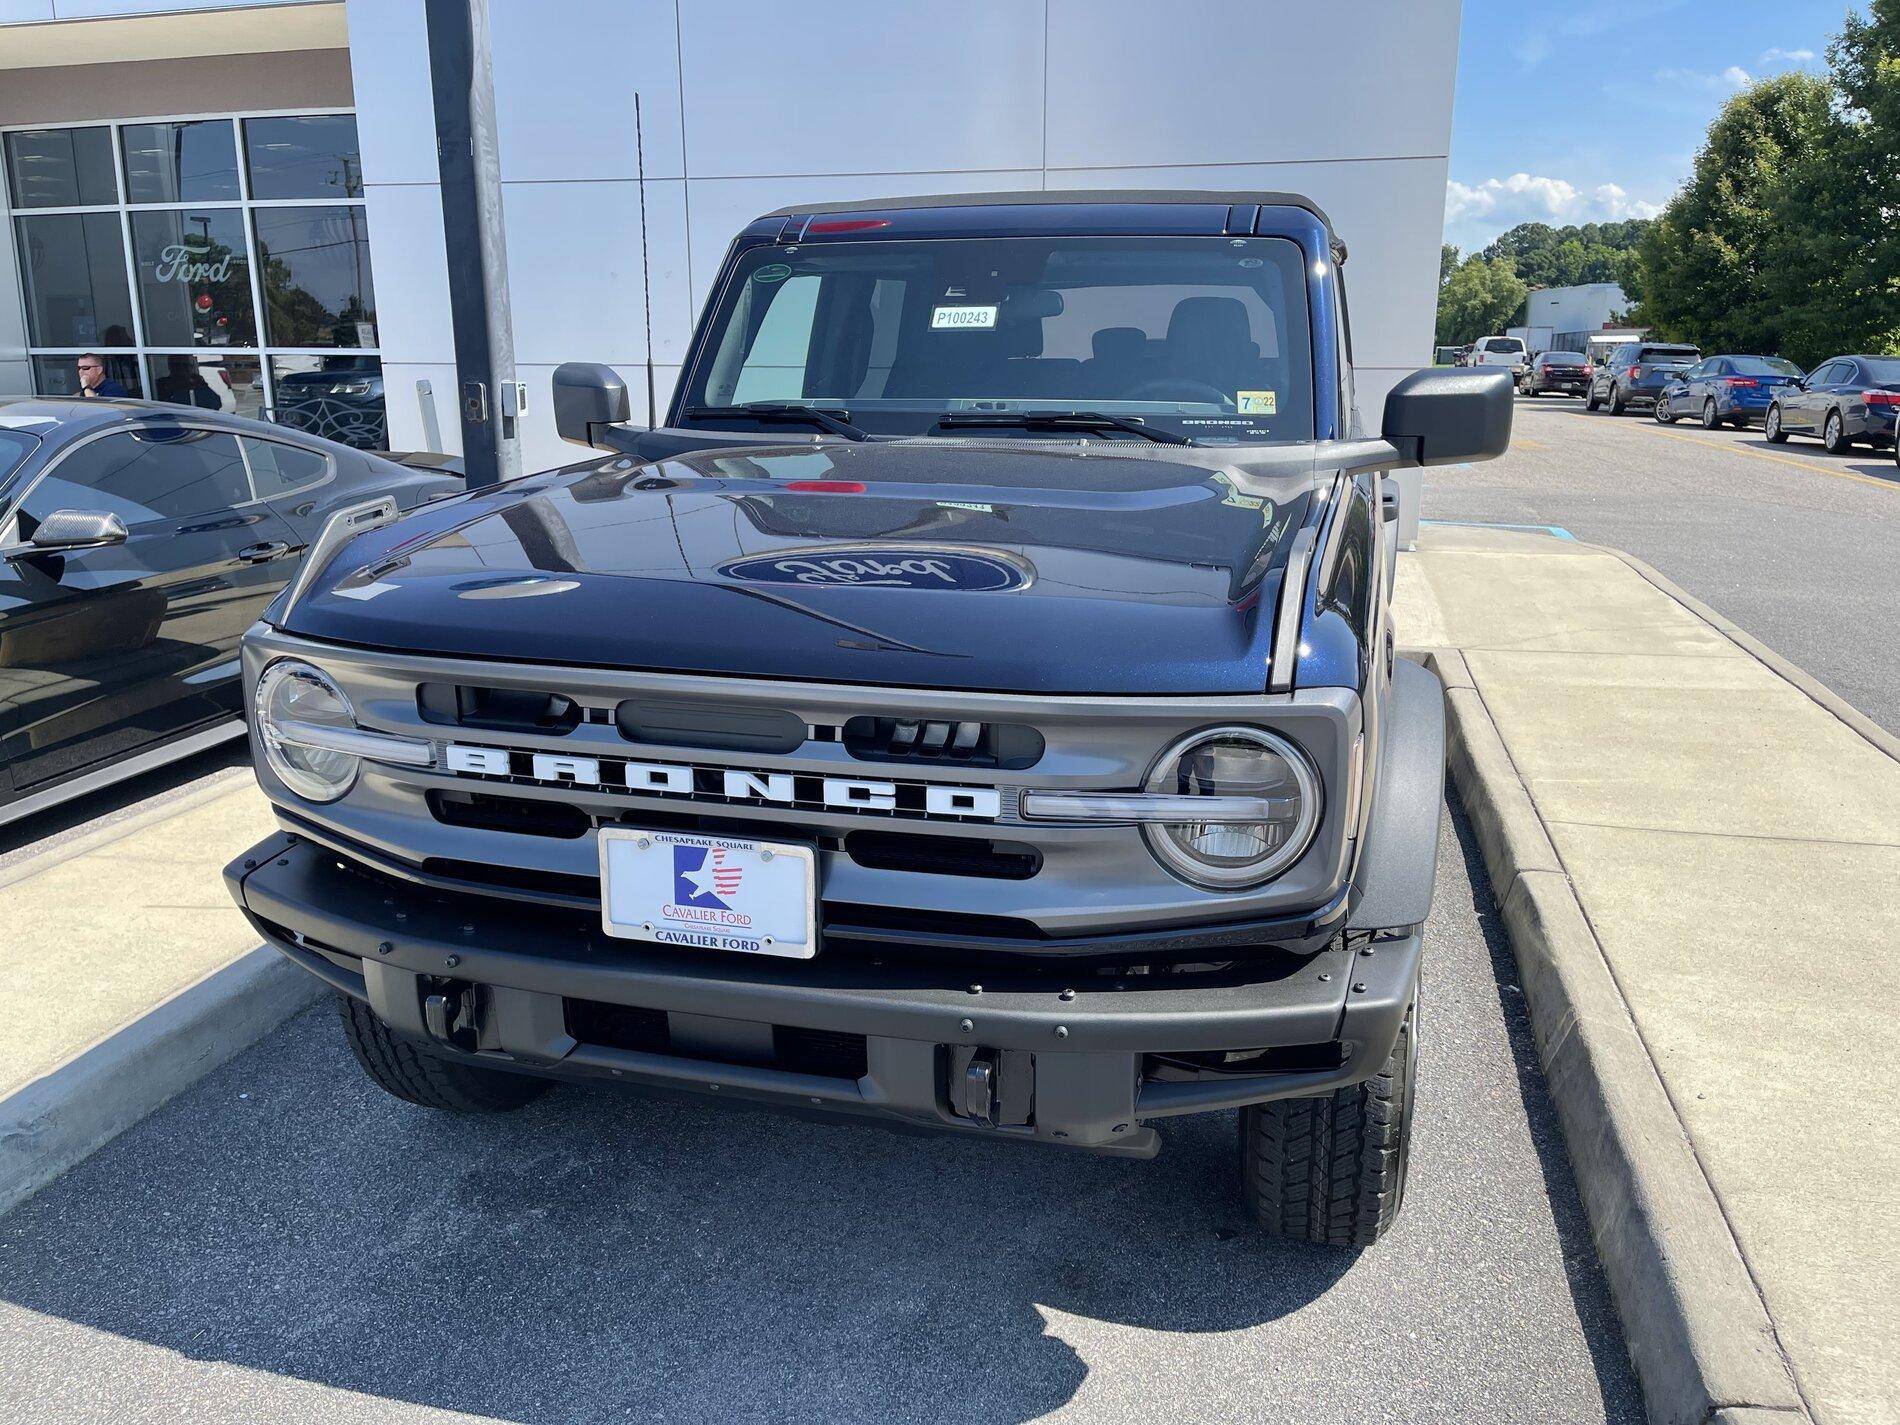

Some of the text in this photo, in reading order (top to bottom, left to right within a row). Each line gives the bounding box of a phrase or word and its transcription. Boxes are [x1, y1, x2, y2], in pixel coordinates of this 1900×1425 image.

[156, 245, 232, 283] Ford
[938, 312, 988, 325] P100243
[1242, 397, 1274, 409] 7 22
[446, 744, 1001, 818] BRONCO
[655, 835, 754, 850] CHESAPEAKE SQUARE
[662, 904, 752, 925] CAVALIER FORD
[655, 931, 760, 951] CAVALIER FORD
